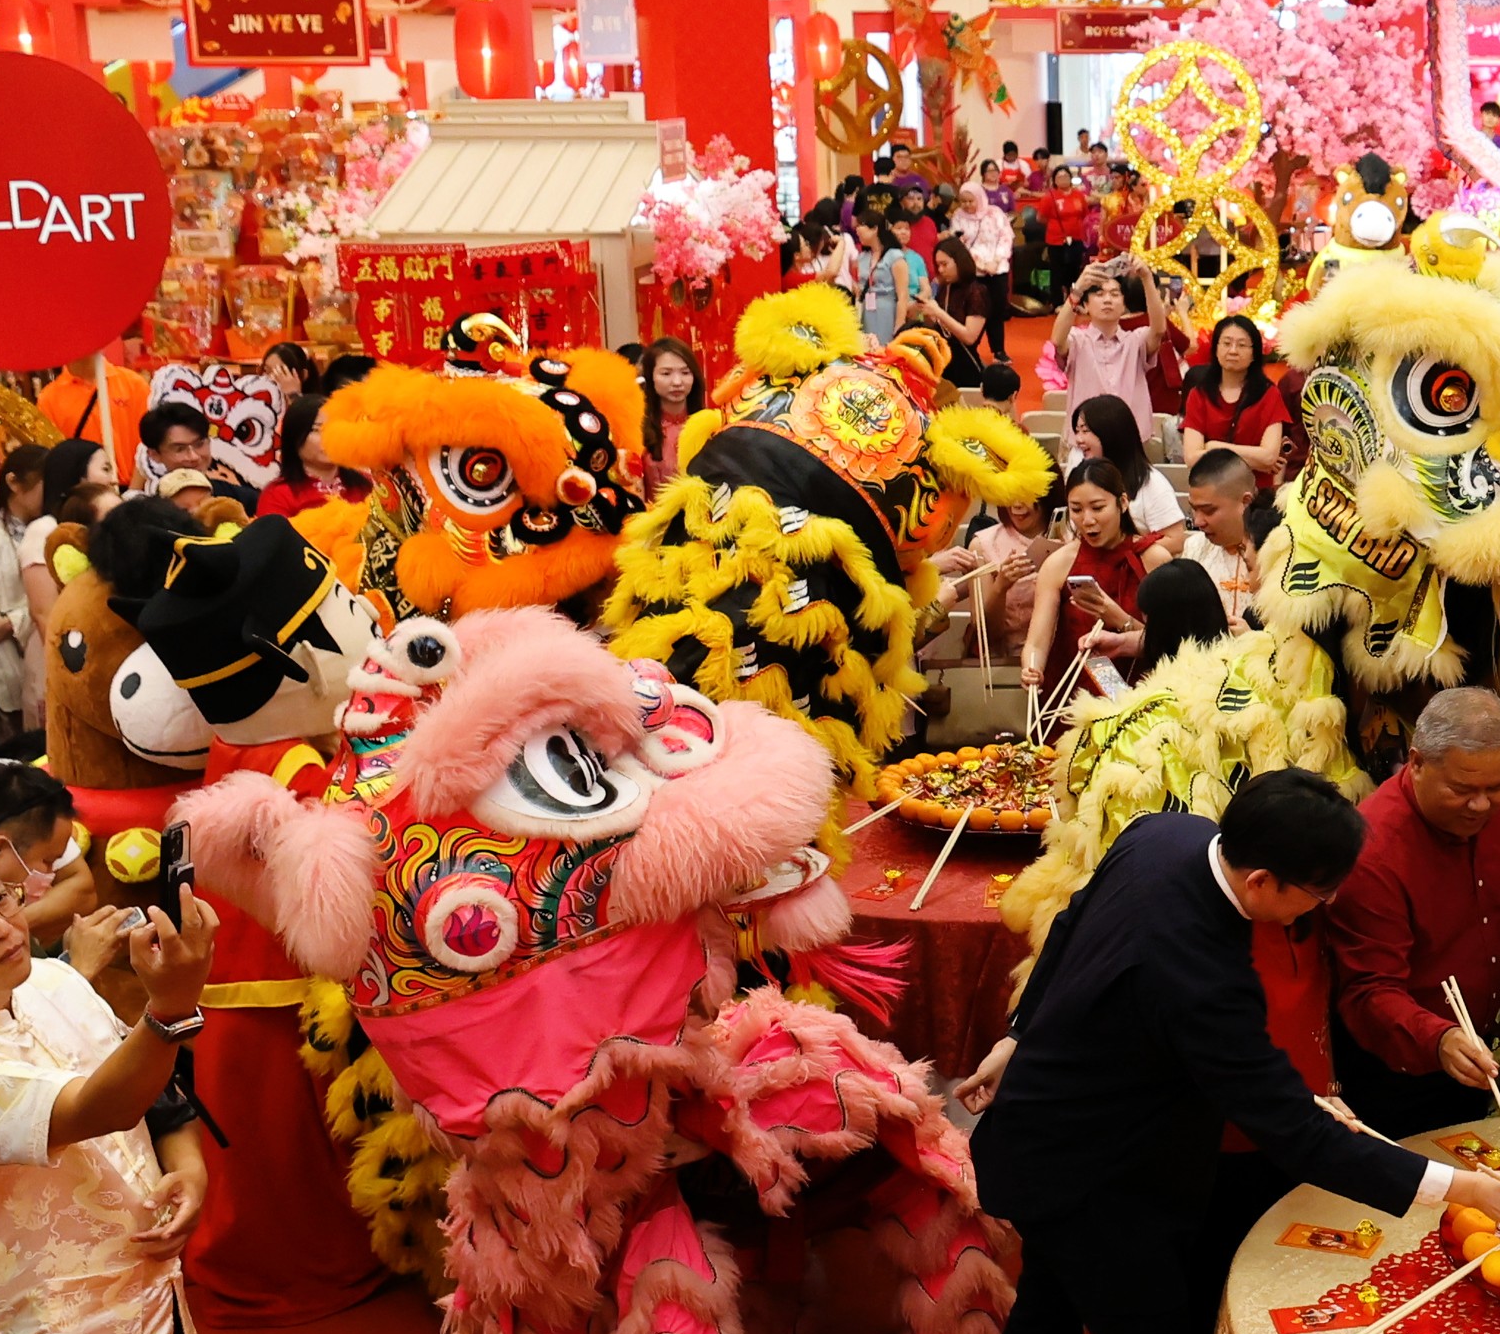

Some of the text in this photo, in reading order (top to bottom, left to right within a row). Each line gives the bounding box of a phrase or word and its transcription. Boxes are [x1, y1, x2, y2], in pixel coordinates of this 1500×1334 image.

[228, 14, 324, 34] JIN YE YE
[1347, 527, 1419, 581] BHD
